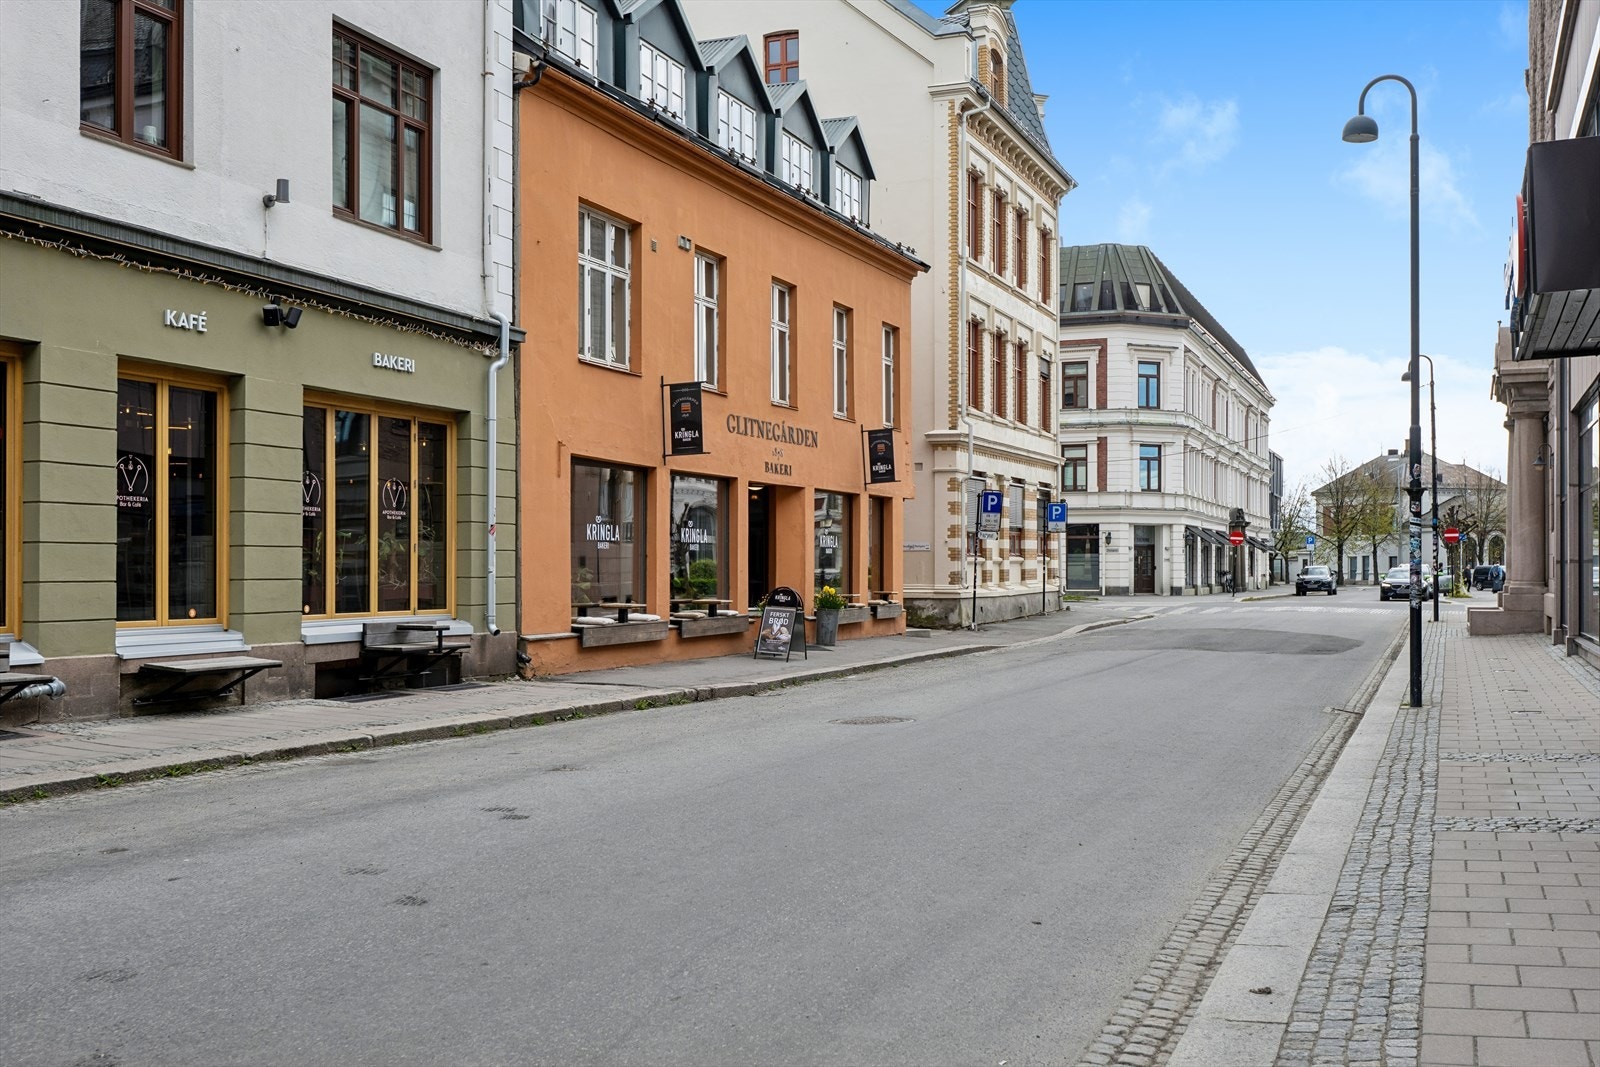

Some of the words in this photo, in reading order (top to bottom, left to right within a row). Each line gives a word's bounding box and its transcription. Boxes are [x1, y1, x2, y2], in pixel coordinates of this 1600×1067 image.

[164, 309, 208, 332] KAFÉ
[373, 352, 415, 373] BAKERI
[674, 430, 699, 439] KRINGLA
[764, 461, 792, 477] BAKERI
[872, 464, 892, 472] KRINGLA
[987, 495, 998, 511] P
[1052, 505, 1062, 520] P
[586, 523, 621, 541] KRINGLA
[680, 527, 708, 543] KRINGLA
[819, 535, 839, 548] KRINGLA
